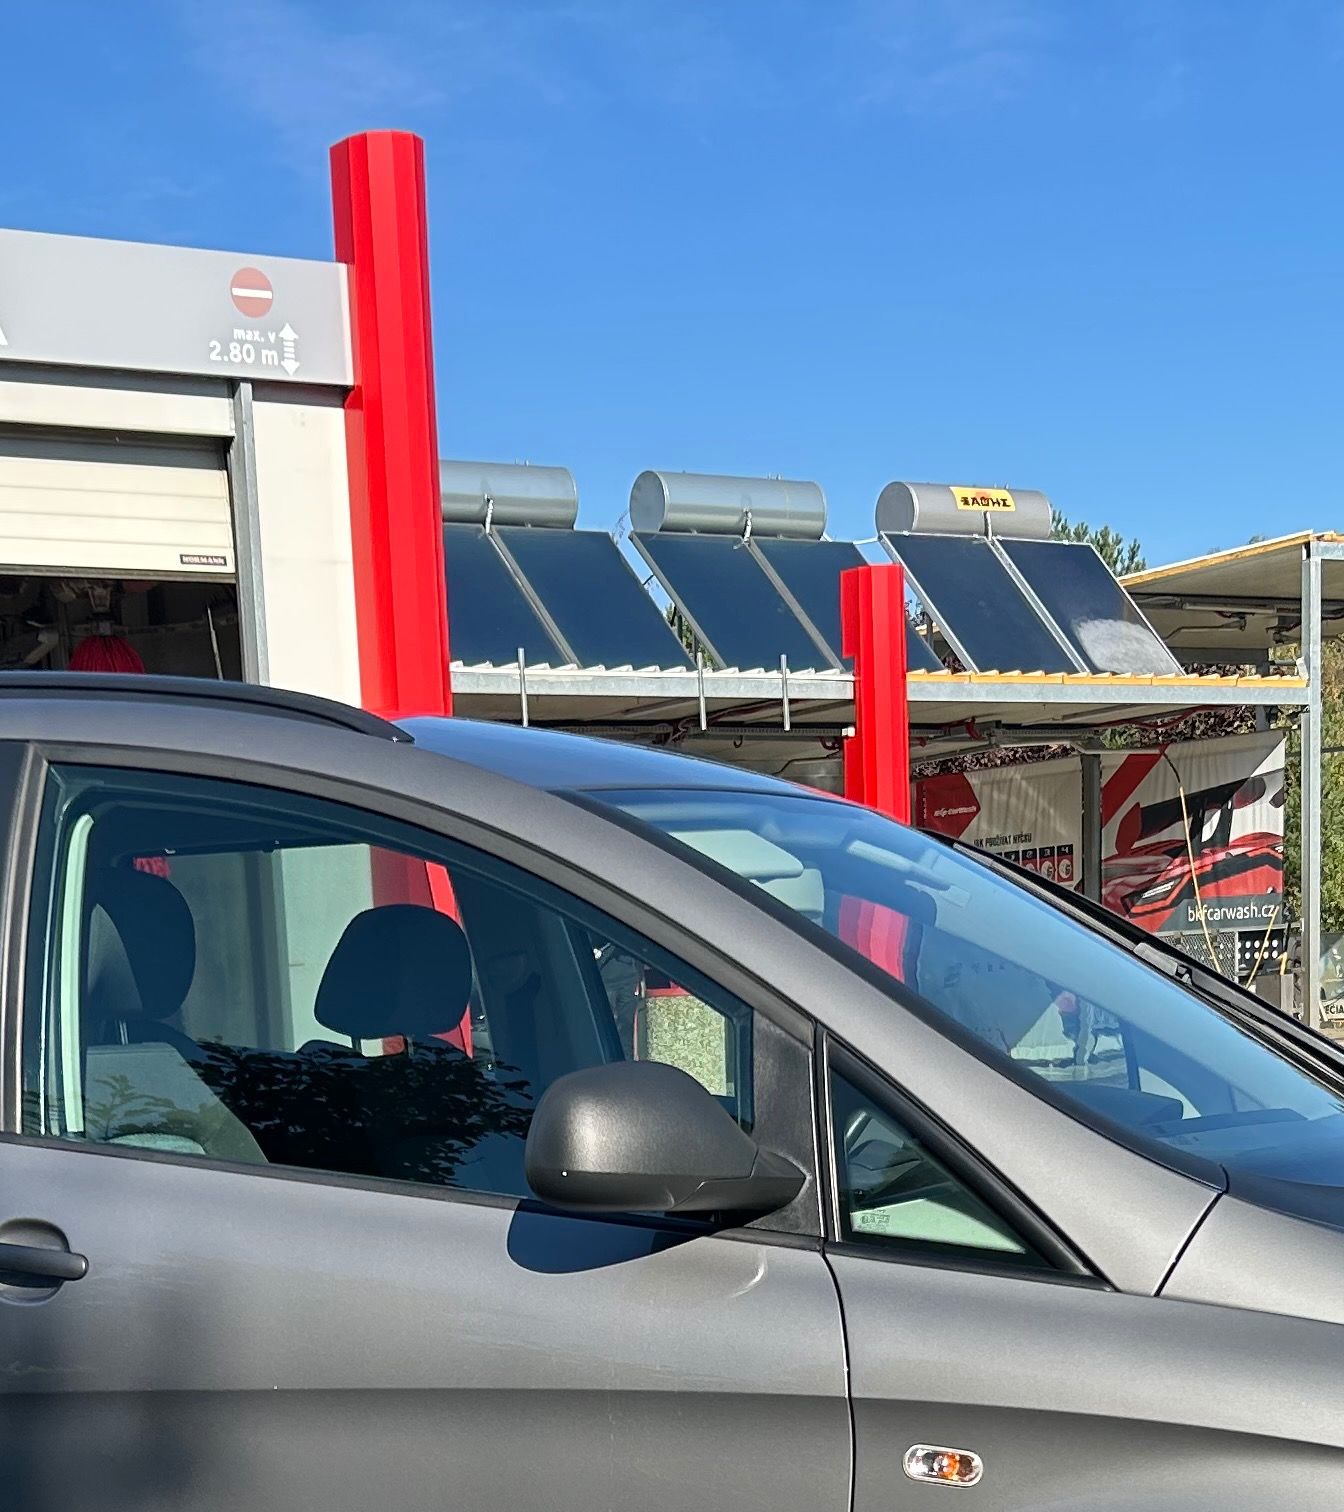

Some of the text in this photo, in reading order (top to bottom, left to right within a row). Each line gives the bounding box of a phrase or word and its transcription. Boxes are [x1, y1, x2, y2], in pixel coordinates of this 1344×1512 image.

[233, 328, 265, 342] max.
[208, 340, 279, 366] 2.80 m
[1188, 901, 1275, 922] bkfcarwash.cz
